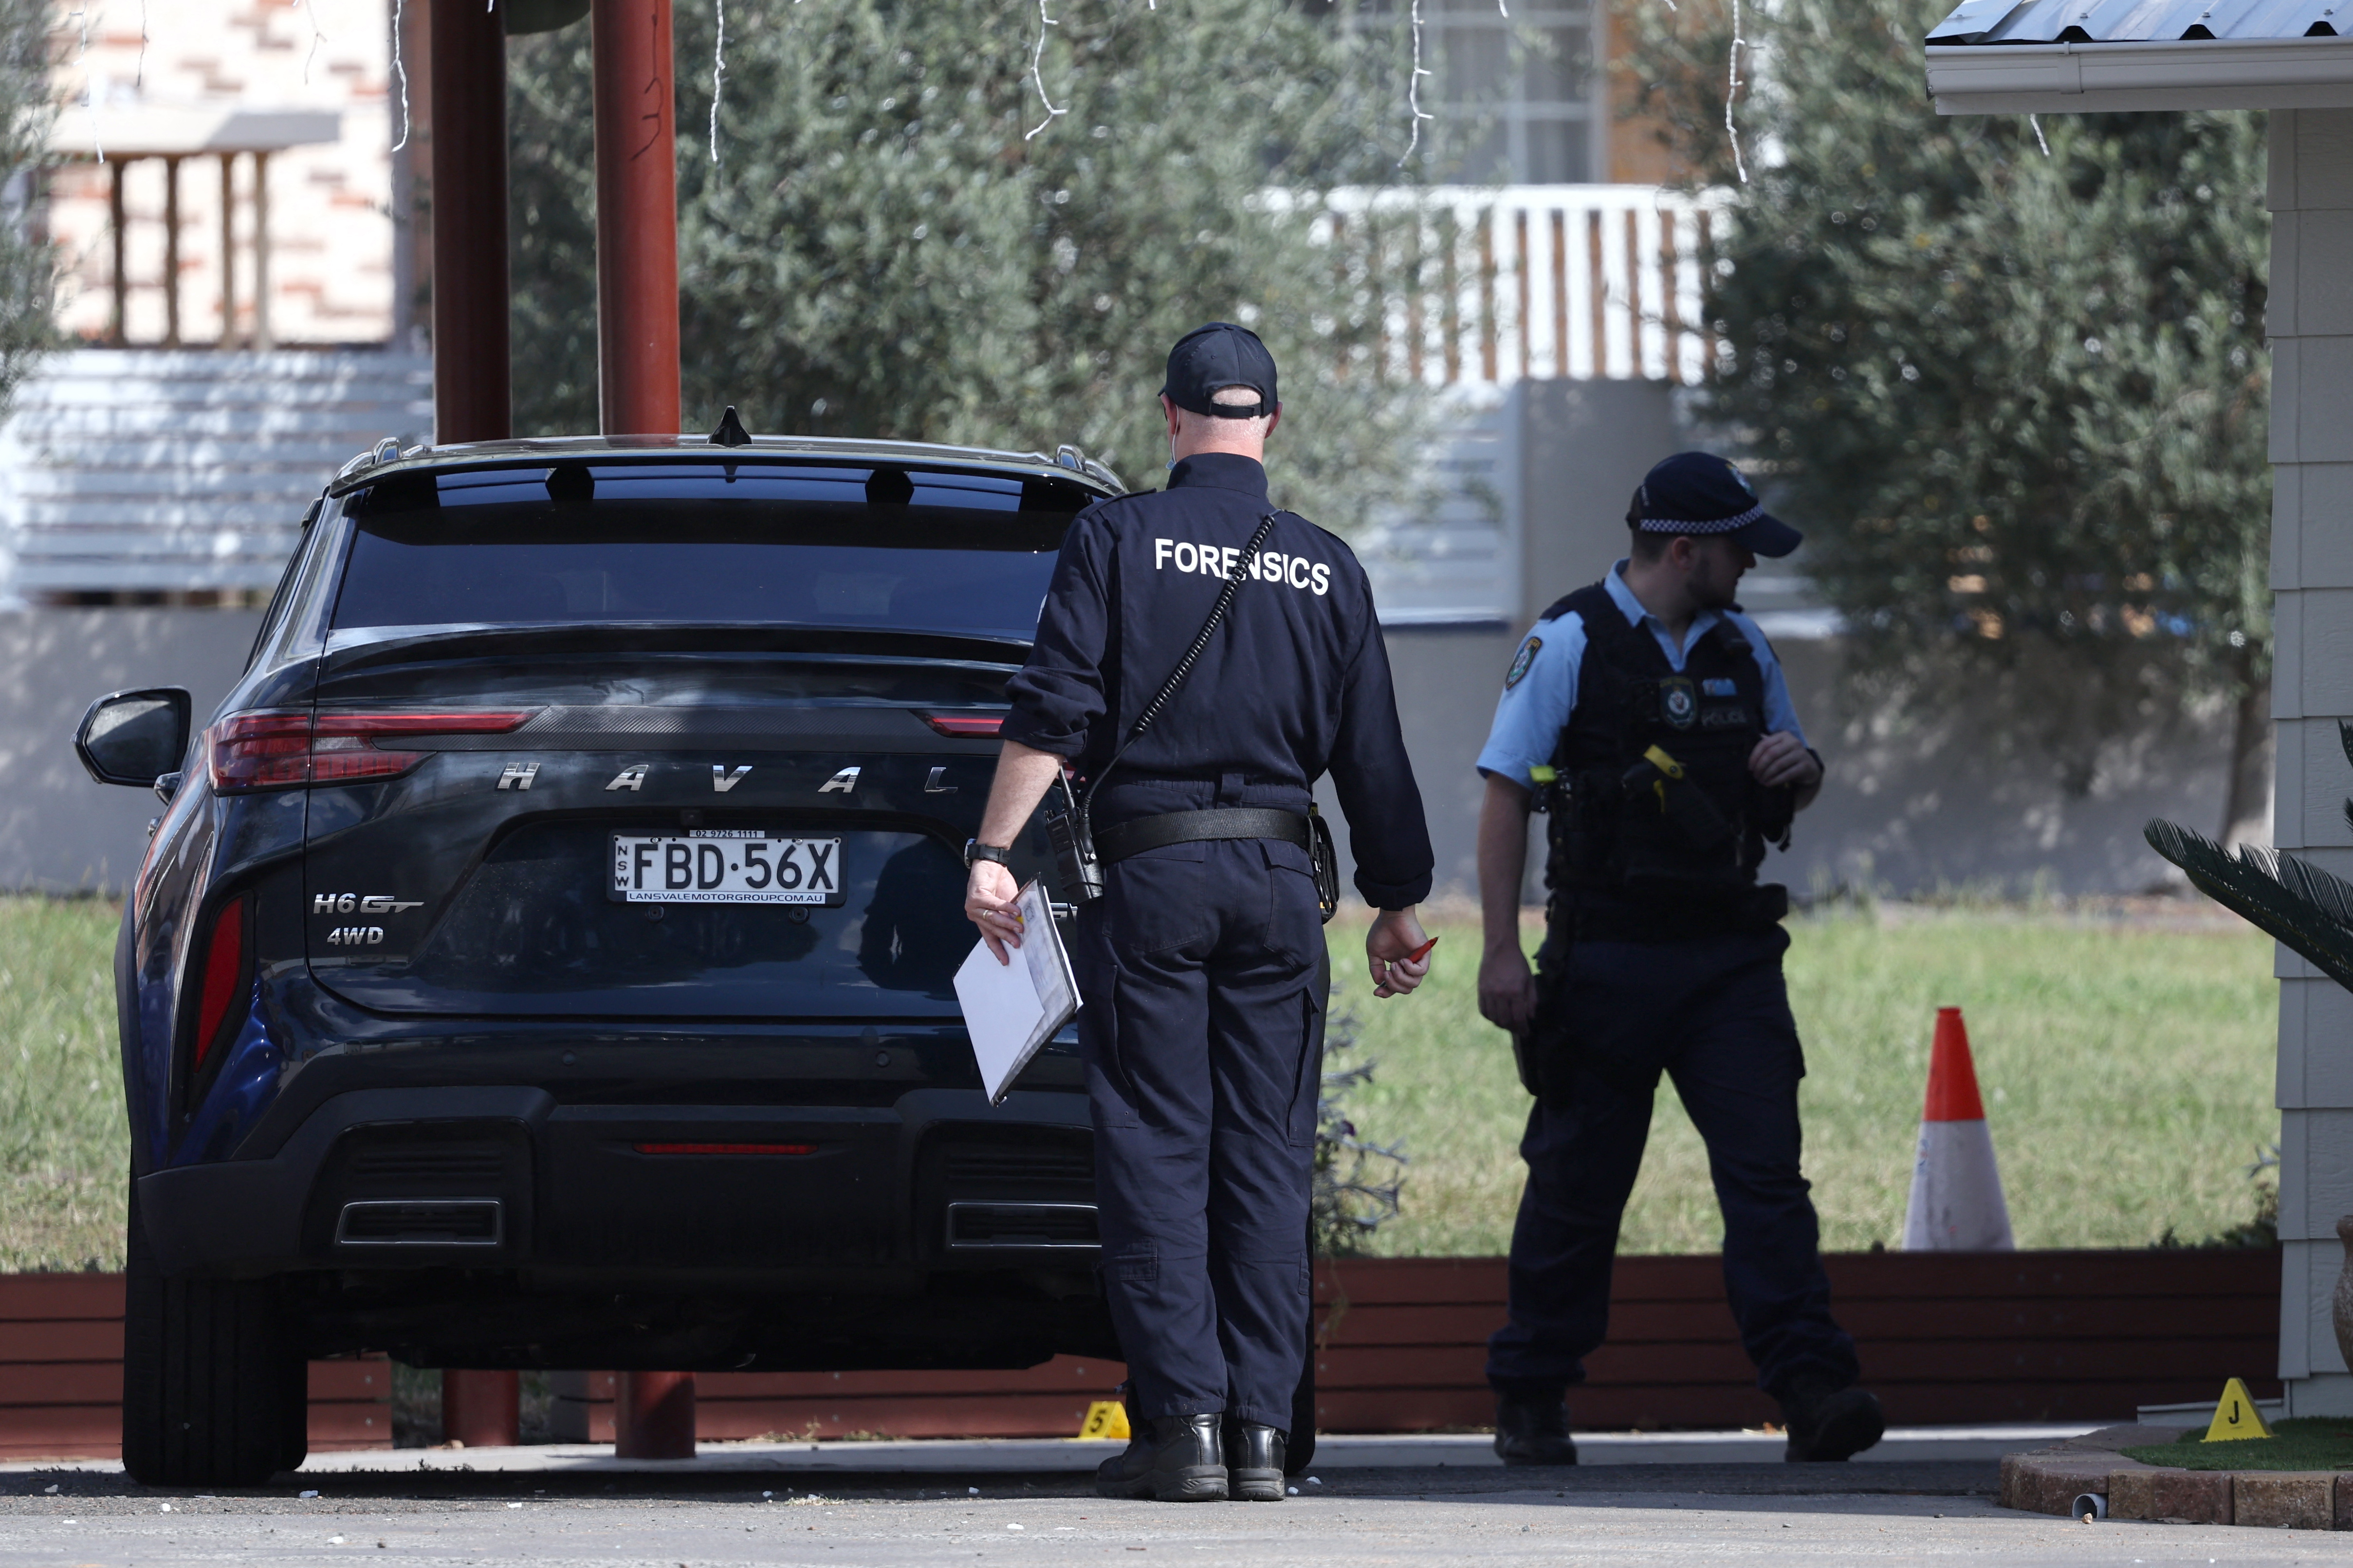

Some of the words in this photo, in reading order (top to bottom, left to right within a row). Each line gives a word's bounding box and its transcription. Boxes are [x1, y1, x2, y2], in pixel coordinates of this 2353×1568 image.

[1155, 538, 1330, 596] FORENSICS
[497, 763, 958, 793] HAVAL
[615, 846, 629, 887] NSW
[313, 893, 356, 914] H6
[360, 896, 424, 913] GT
[629, 893, 823, 902] LANSVALEMOTORGROUP.COM.AU
[327, 927, 384, 945] 4WD
[1090, 1408, 1107, 1433] 5
[2228, 1400, 2239, 1424] J
